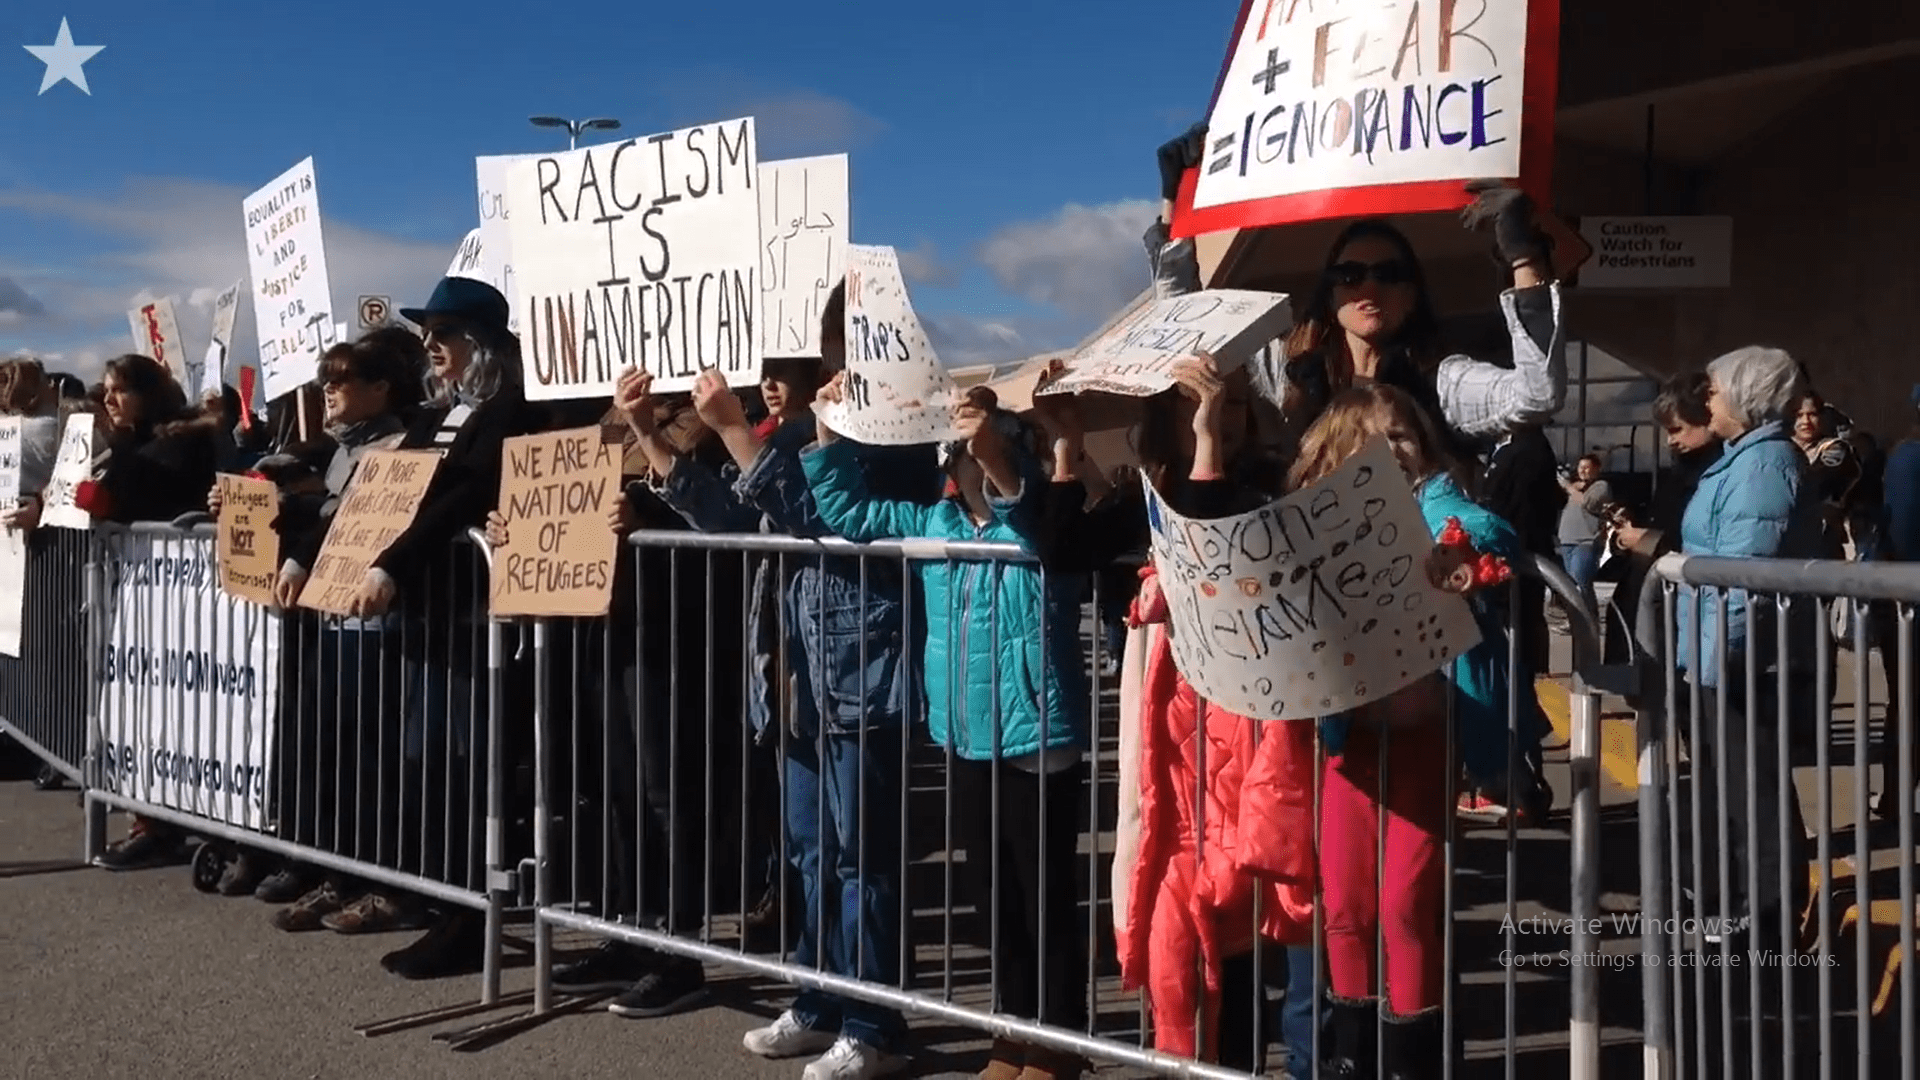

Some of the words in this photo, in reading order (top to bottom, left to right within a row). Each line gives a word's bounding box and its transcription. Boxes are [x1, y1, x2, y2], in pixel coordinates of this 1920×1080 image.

[1312, 0, 1497, 89] FEAR
[536, 118, 751, 224] RACISM
[248, 181, 297, 228] EQUALITY
[300, 174, 312, 193] IS
[256, 205, 307, 257] LIBERTY
[592, 206, 670, 287] IS
[1601, 237, 1653, 251] Watch
[1659, 237, 1684, 251] for
[273, 239, 296, 267] AND
[1599, 253, 1696, 268] Pedestrians
[261, 254, 308, 298] JUSTICE
[279, 299, 306, 328] FOR
[530, 266, 754, 386] UNAMERICAN
[281, 329, 306, 356] ALL
[358, 457, 380, 485] NO
[383, 459, 420, 485] MORE
[510, 444, 543, 480] WE
[551, 437, 588, 476] ARE
[593, 442, 611, 468] A
[223, 476, 269, 512] Refugees
[508, 477, 606, 523] NATION
[230, 526, 255, 550] NOT
[234, 514, 250, 525] are
[538, 521, 570, 553] OF
[507, 553, 609, 594] REFUGEES
